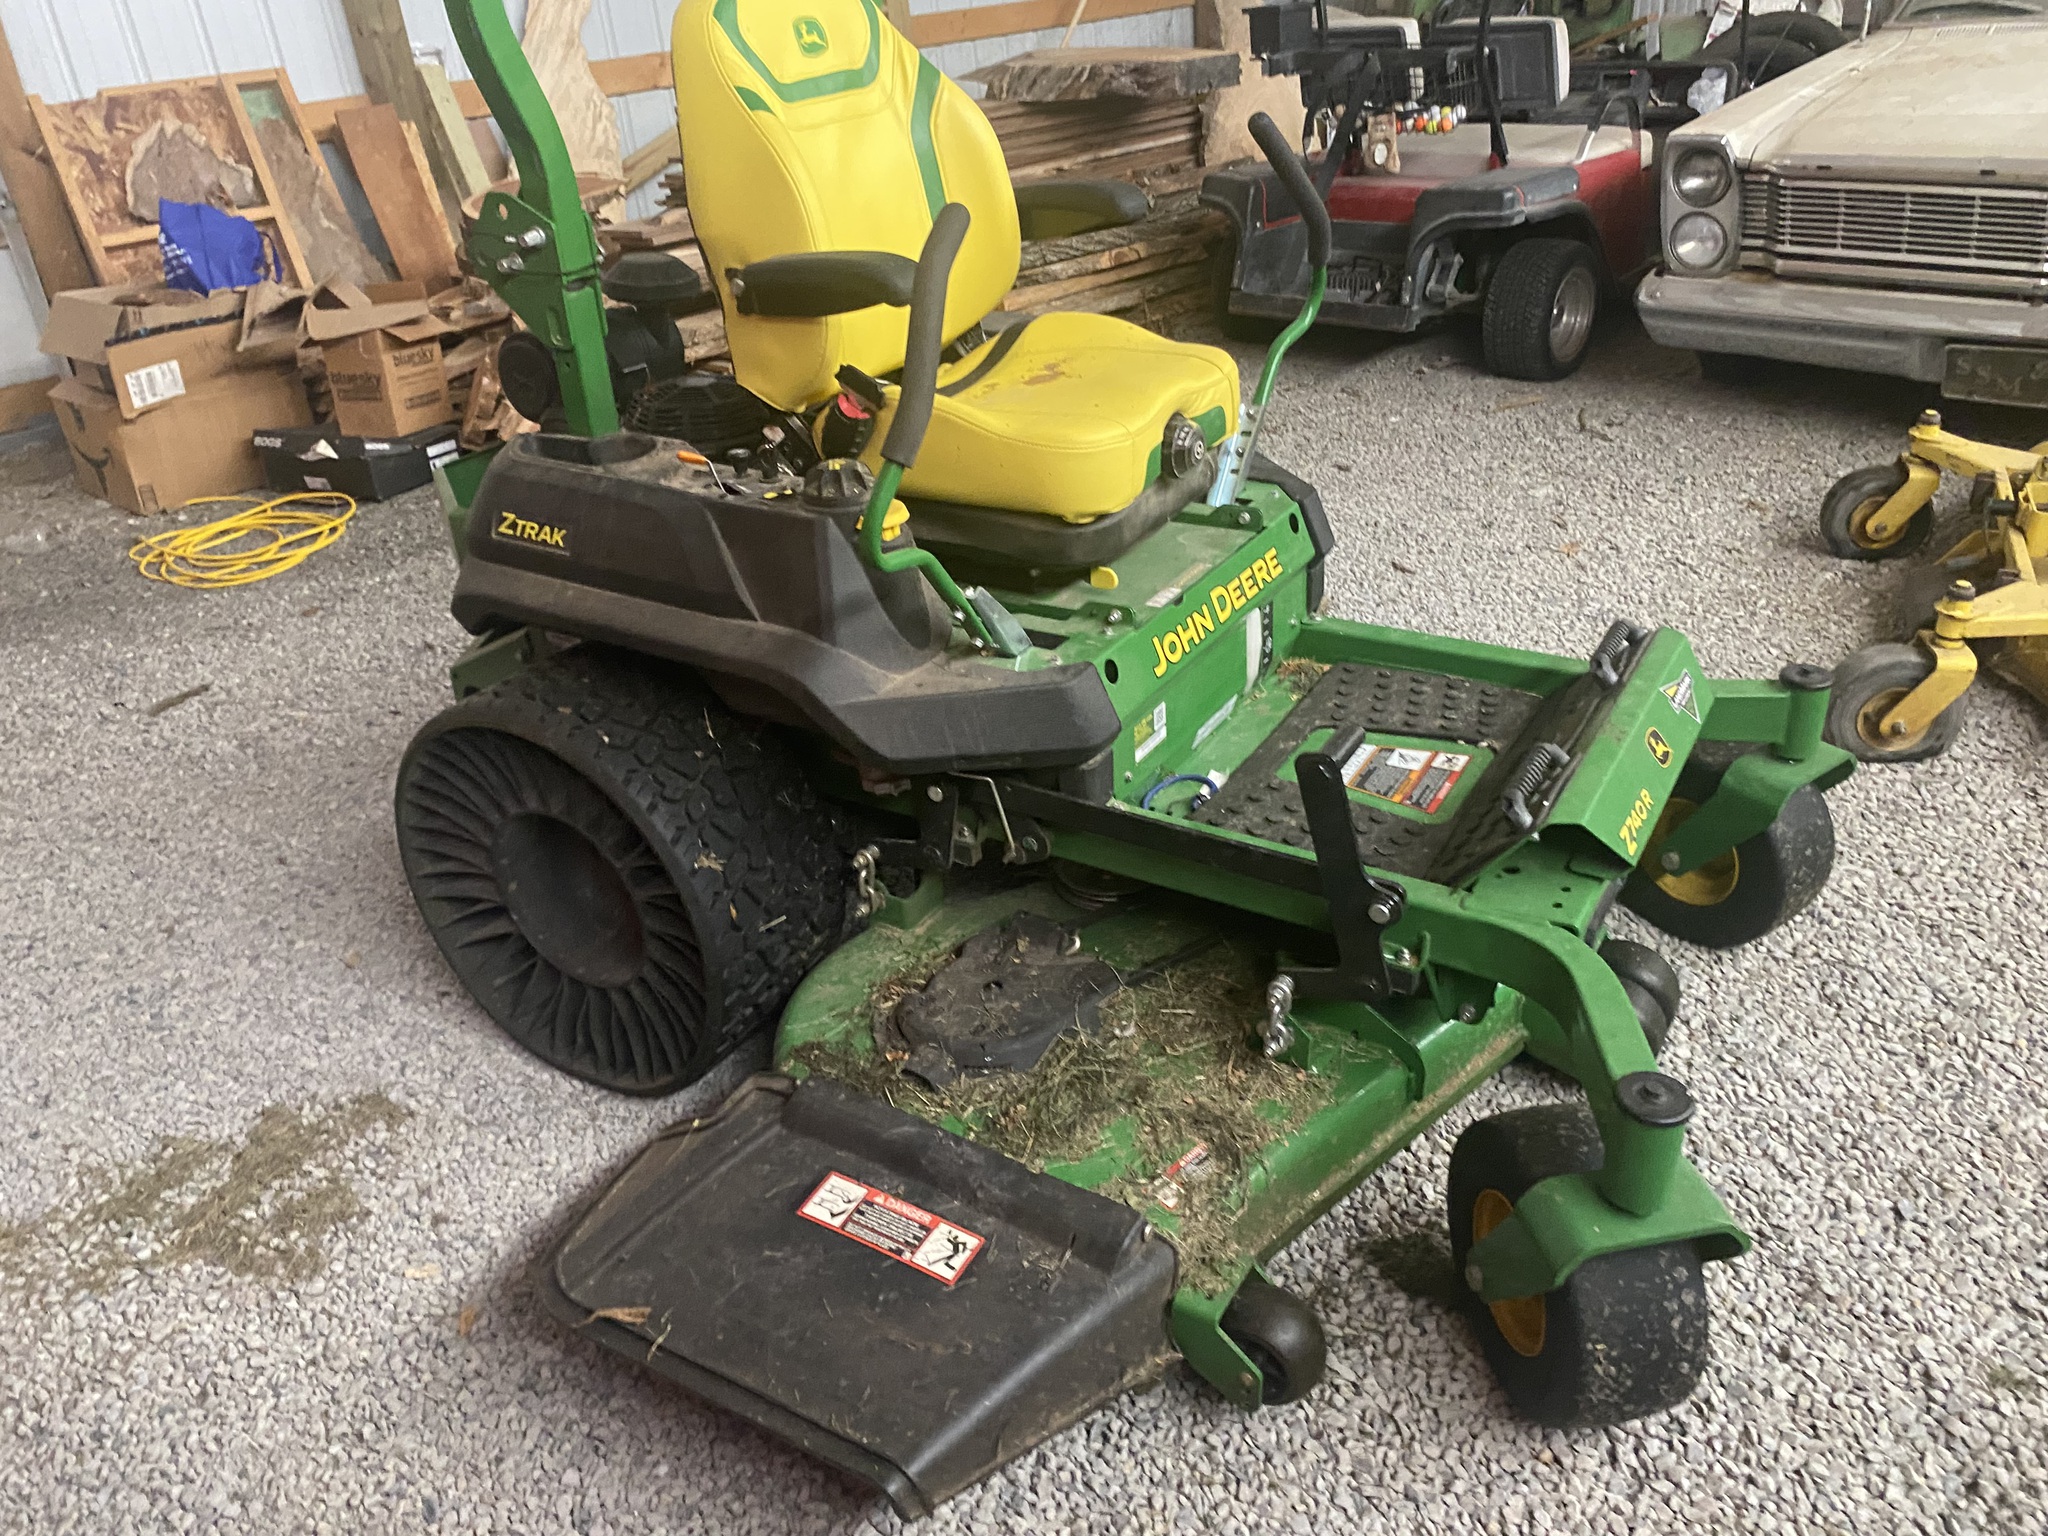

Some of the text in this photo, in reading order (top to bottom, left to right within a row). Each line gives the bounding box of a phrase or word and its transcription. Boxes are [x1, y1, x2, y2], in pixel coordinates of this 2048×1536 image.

[498, 511, 567, 547] ZTRAK
[1151, 603, 1216, 678] JOHN
[1209, 546, 1284, 624] DEERE
[1618, 787, 1655, 857] Z740R
[885, 1196, 933, 1225] DANGER
